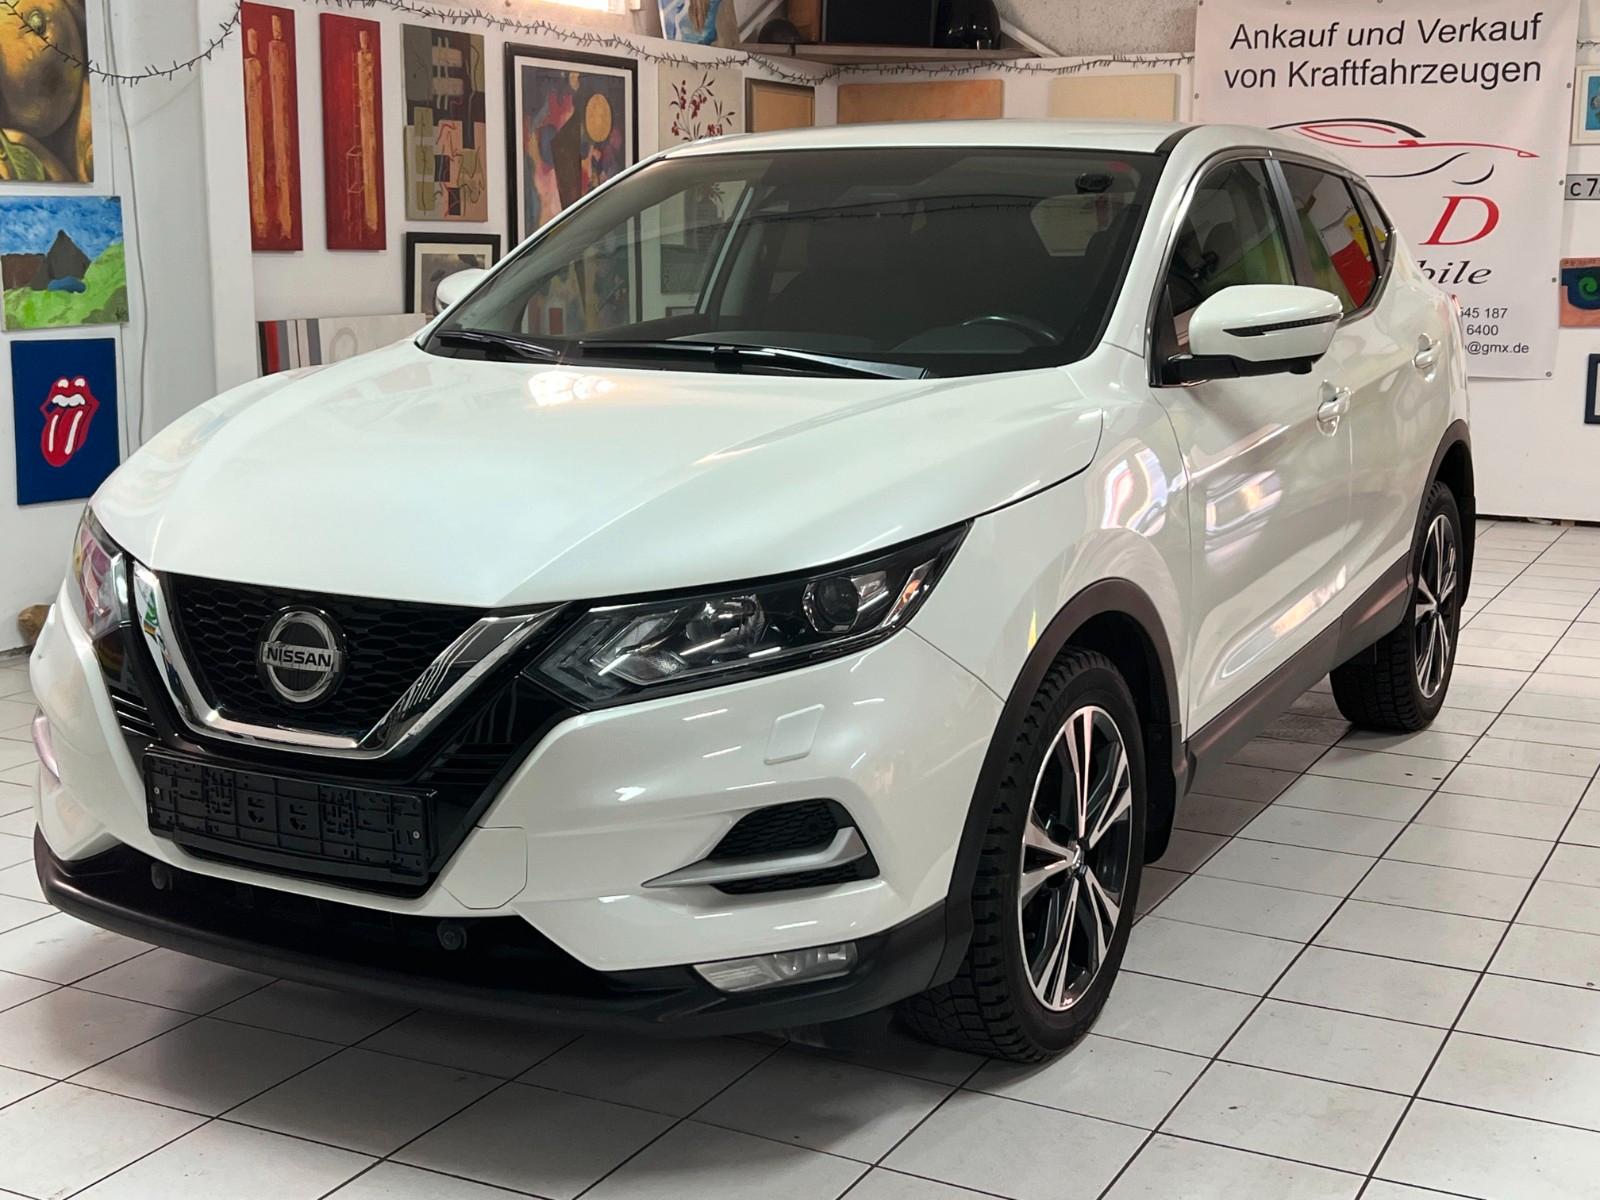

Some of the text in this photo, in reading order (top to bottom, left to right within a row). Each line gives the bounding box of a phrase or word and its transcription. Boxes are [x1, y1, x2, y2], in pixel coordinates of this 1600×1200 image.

[1229, 12, 1543, 50] Ankauf und Verkauf
[1224, 58, 1541, 90] von Kraftfahrzeugen
[1418, 196, 1499, 245] D
[1417, 260, 1492, 284] bile
[1485, 307, 1508, 319] 187
[1466, 324, 1499, 336] 6400
[1465, 341, 1530, 355] @gmx.de
[266, 647, 332, 667] NISSAN
